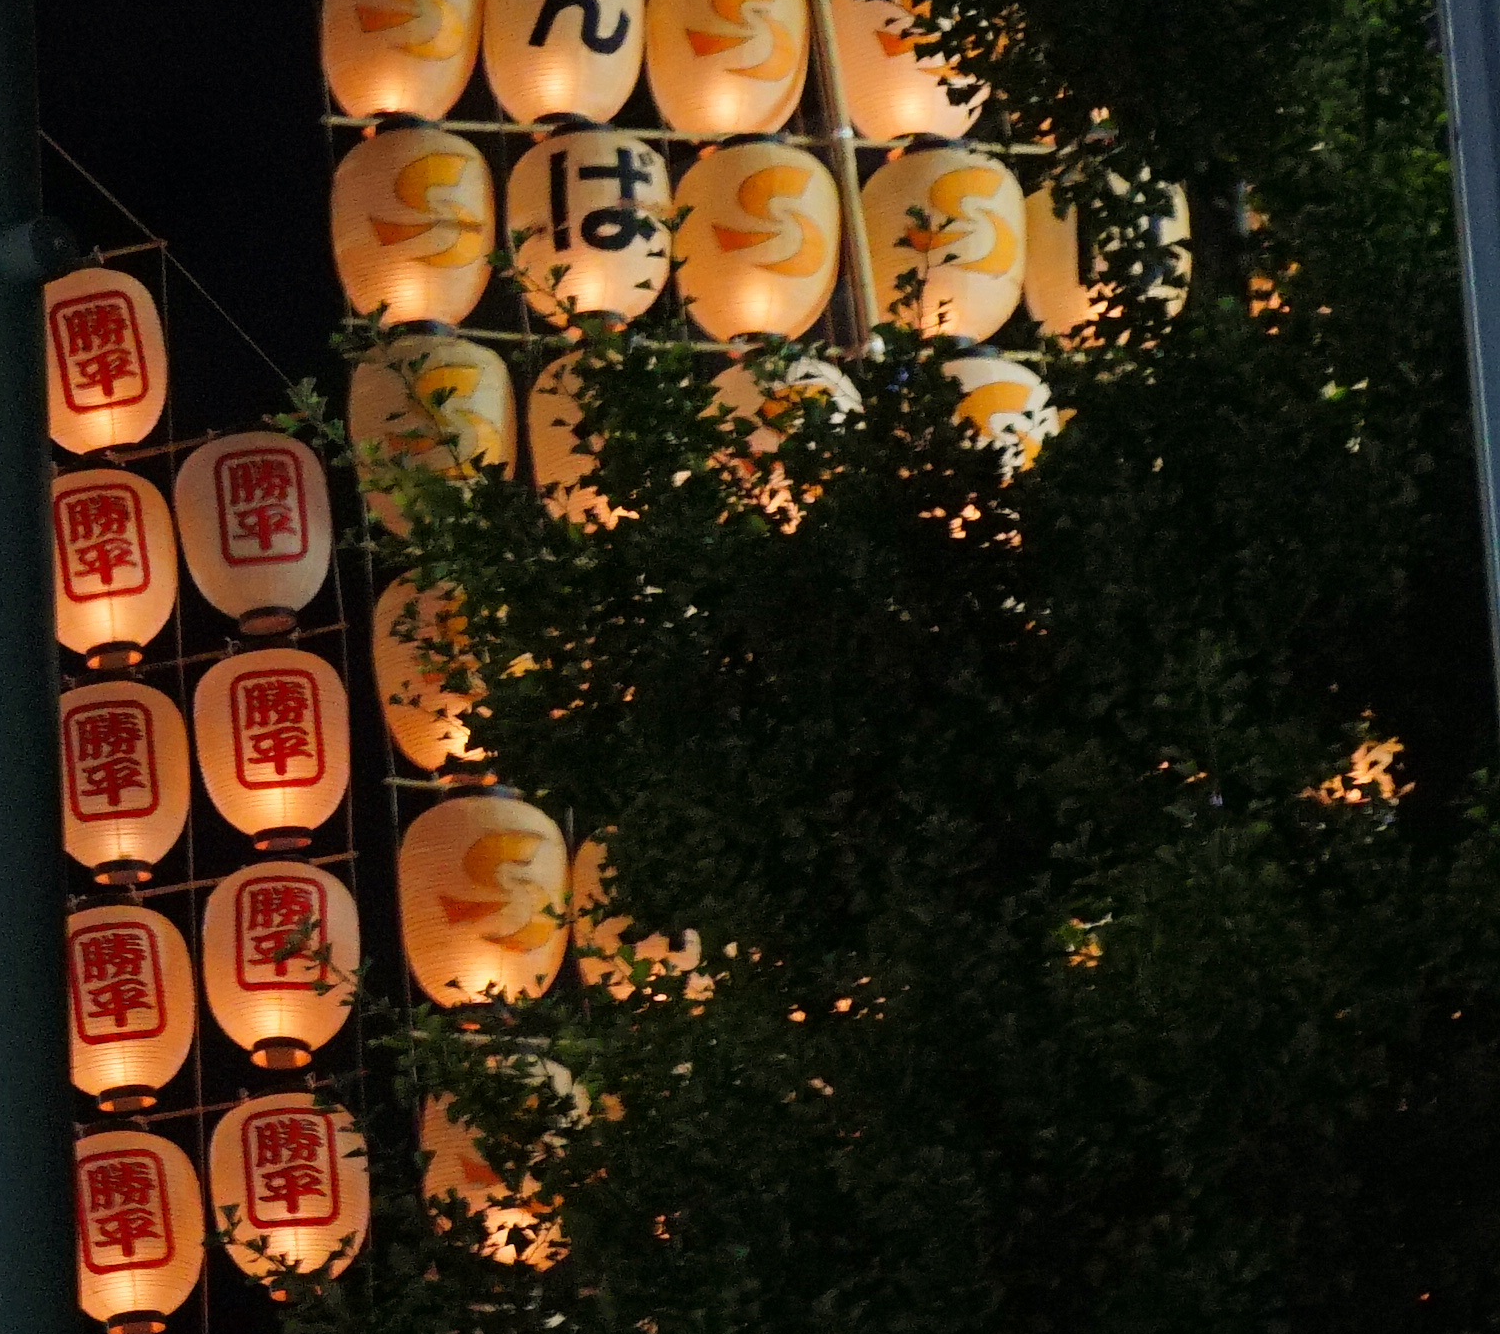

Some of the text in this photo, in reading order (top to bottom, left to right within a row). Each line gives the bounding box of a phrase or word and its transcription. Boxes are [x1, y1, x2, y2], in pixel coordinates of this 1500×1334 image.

[550, 148, 656, 254] ば
[66, 305, 134, 398] 勝平
[68, 494, 137, 585] 勝平
[229, 460, 298, 550] 勝平
[77, 713, 146, 805] 勝平
[245, 681, 314, 774] 勝平
[81, 933, 152, 1027] 勝平
[88, 1161, 161, 1257] 勝平
[256, 1119, 326, 1213] 勝平
